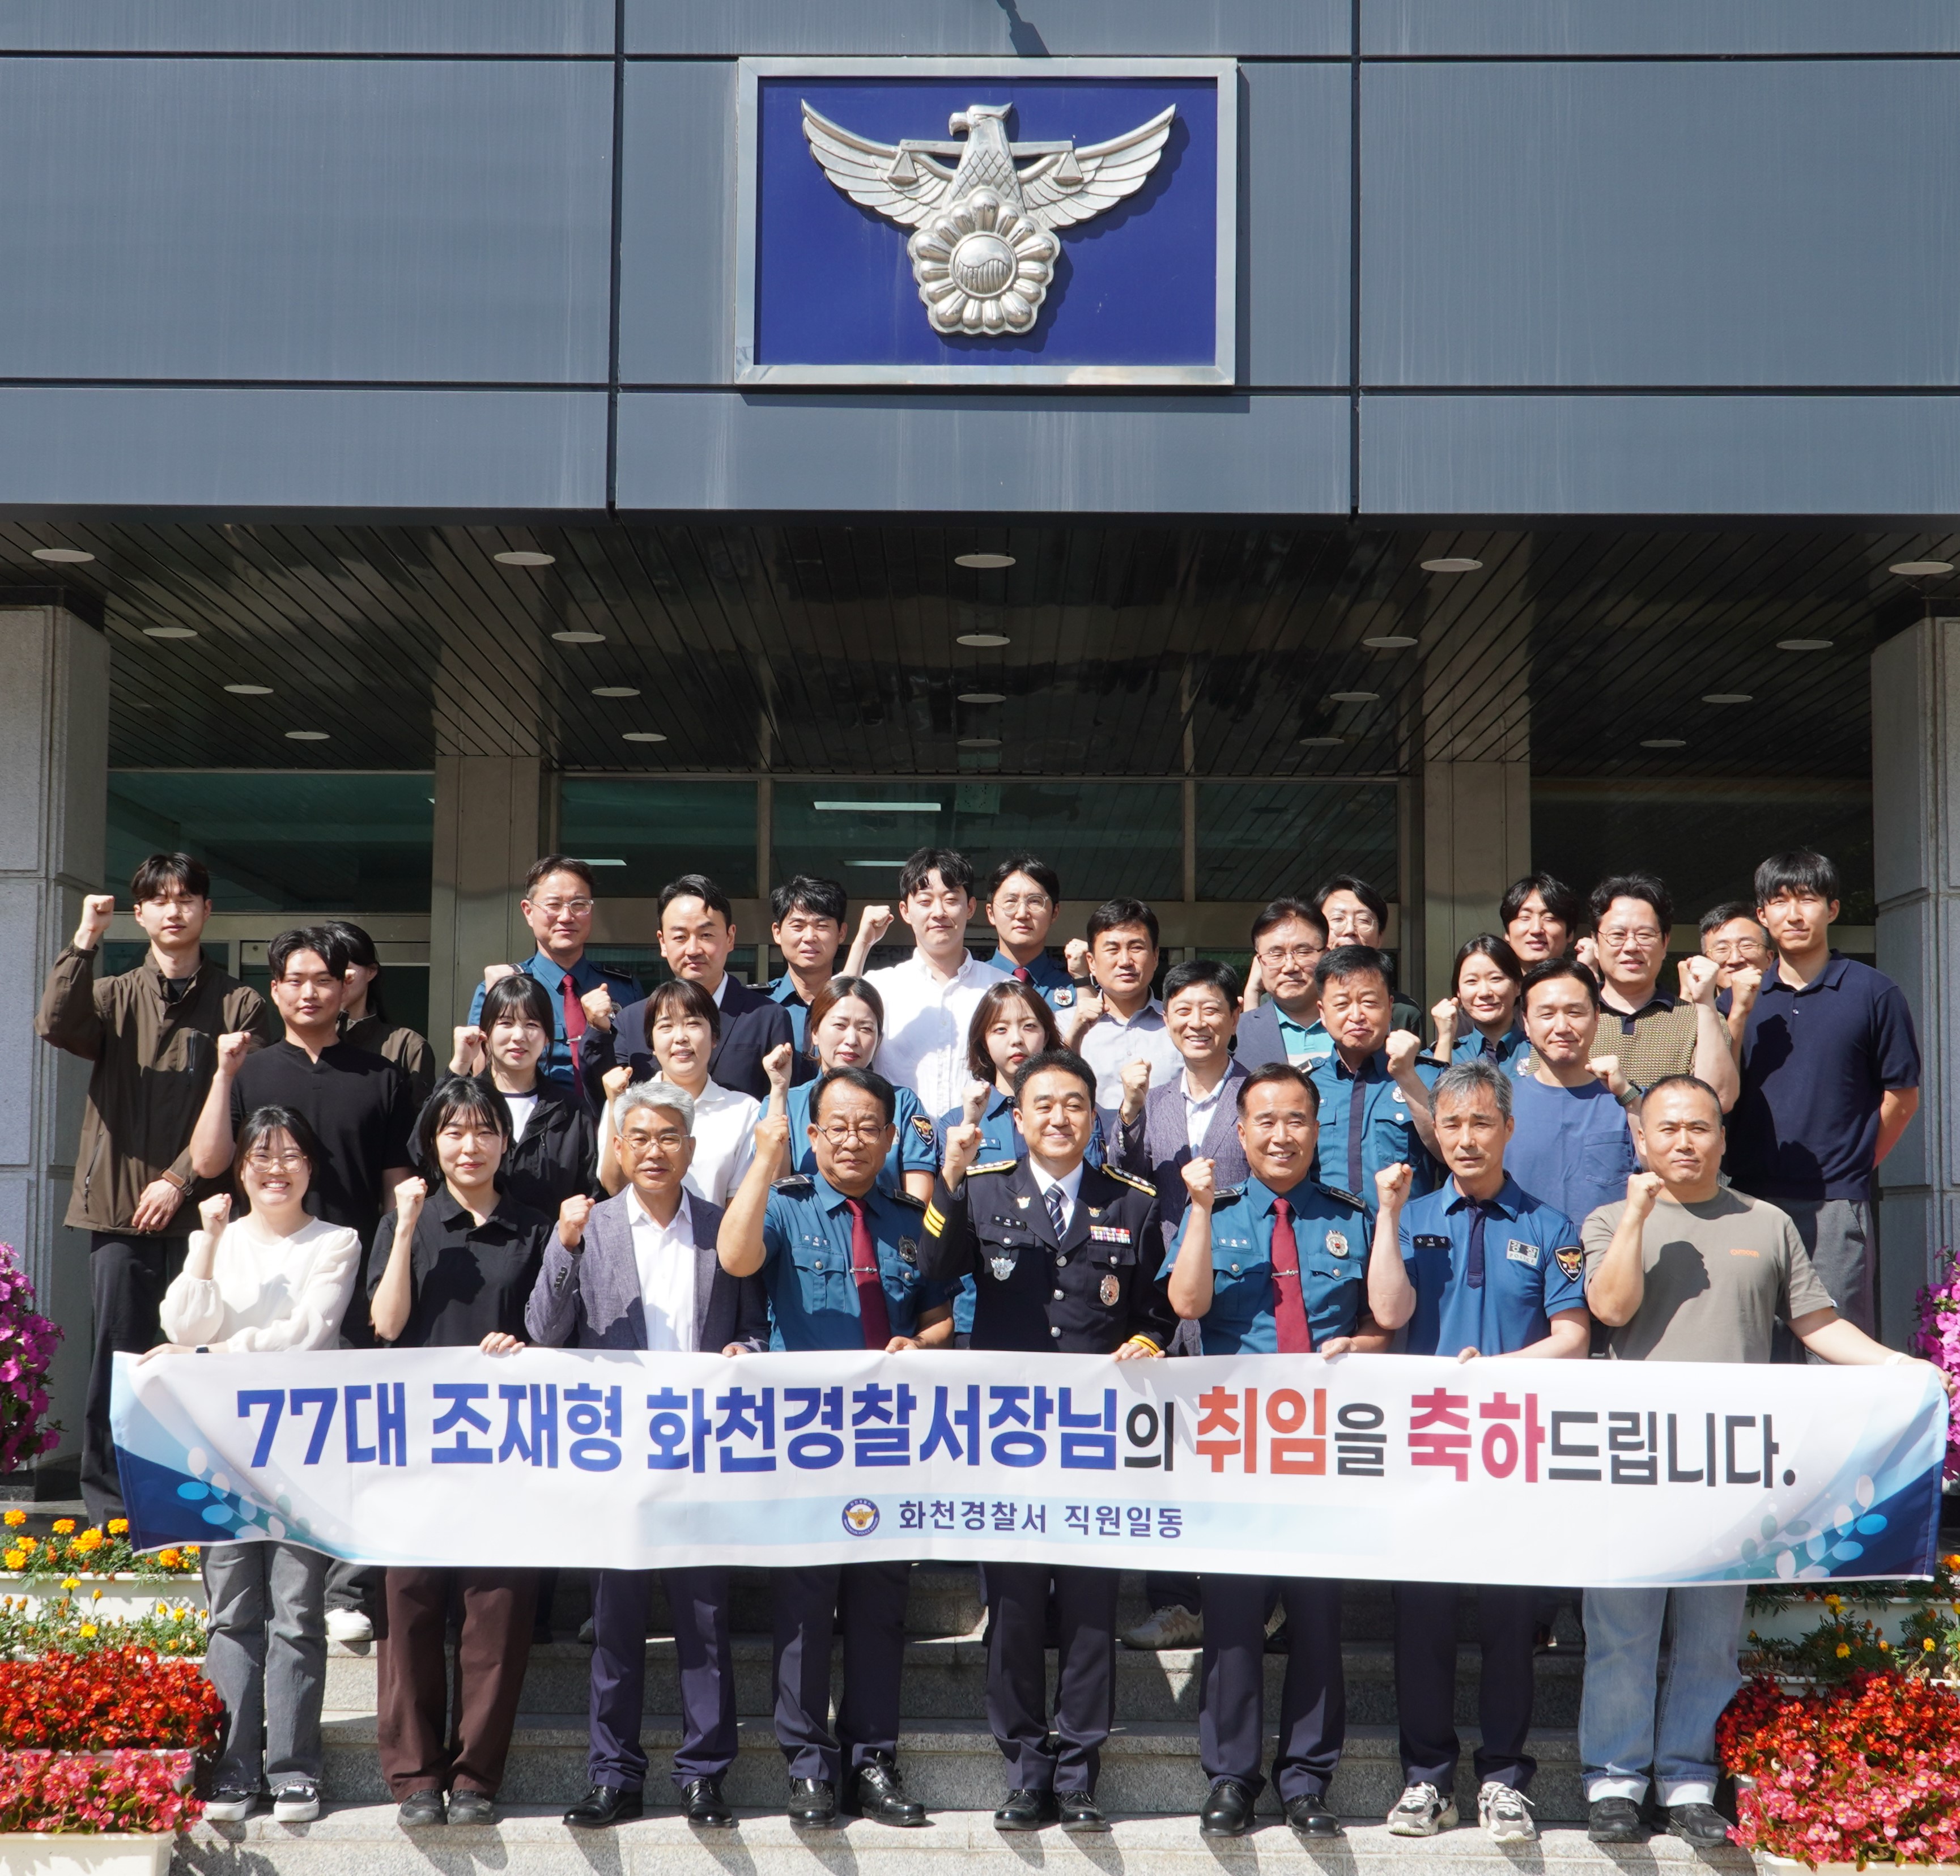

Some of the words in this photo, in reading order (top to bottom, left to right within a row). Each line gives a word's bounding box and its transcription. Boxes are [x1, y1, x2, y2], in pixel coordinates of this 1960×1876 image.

[1509, 1253, 1535, 1264] POLICE
[1510, 1241, 1538, 1258] 경찰
[237, 1382, 407, 1467] 77대
[432, 1382, 622, 1472] 조재형
[647, 1384, 1174, 1473] 화천경찰서장님의
[1196, 1386, 1387, 1477] 취임을
[1408, 1388, 1796, 1488] 축하드립니다.
[899, 1500, 1047, 1533] 화천경찰서
[1064, 1505, 1183, 1538] 직원일동
